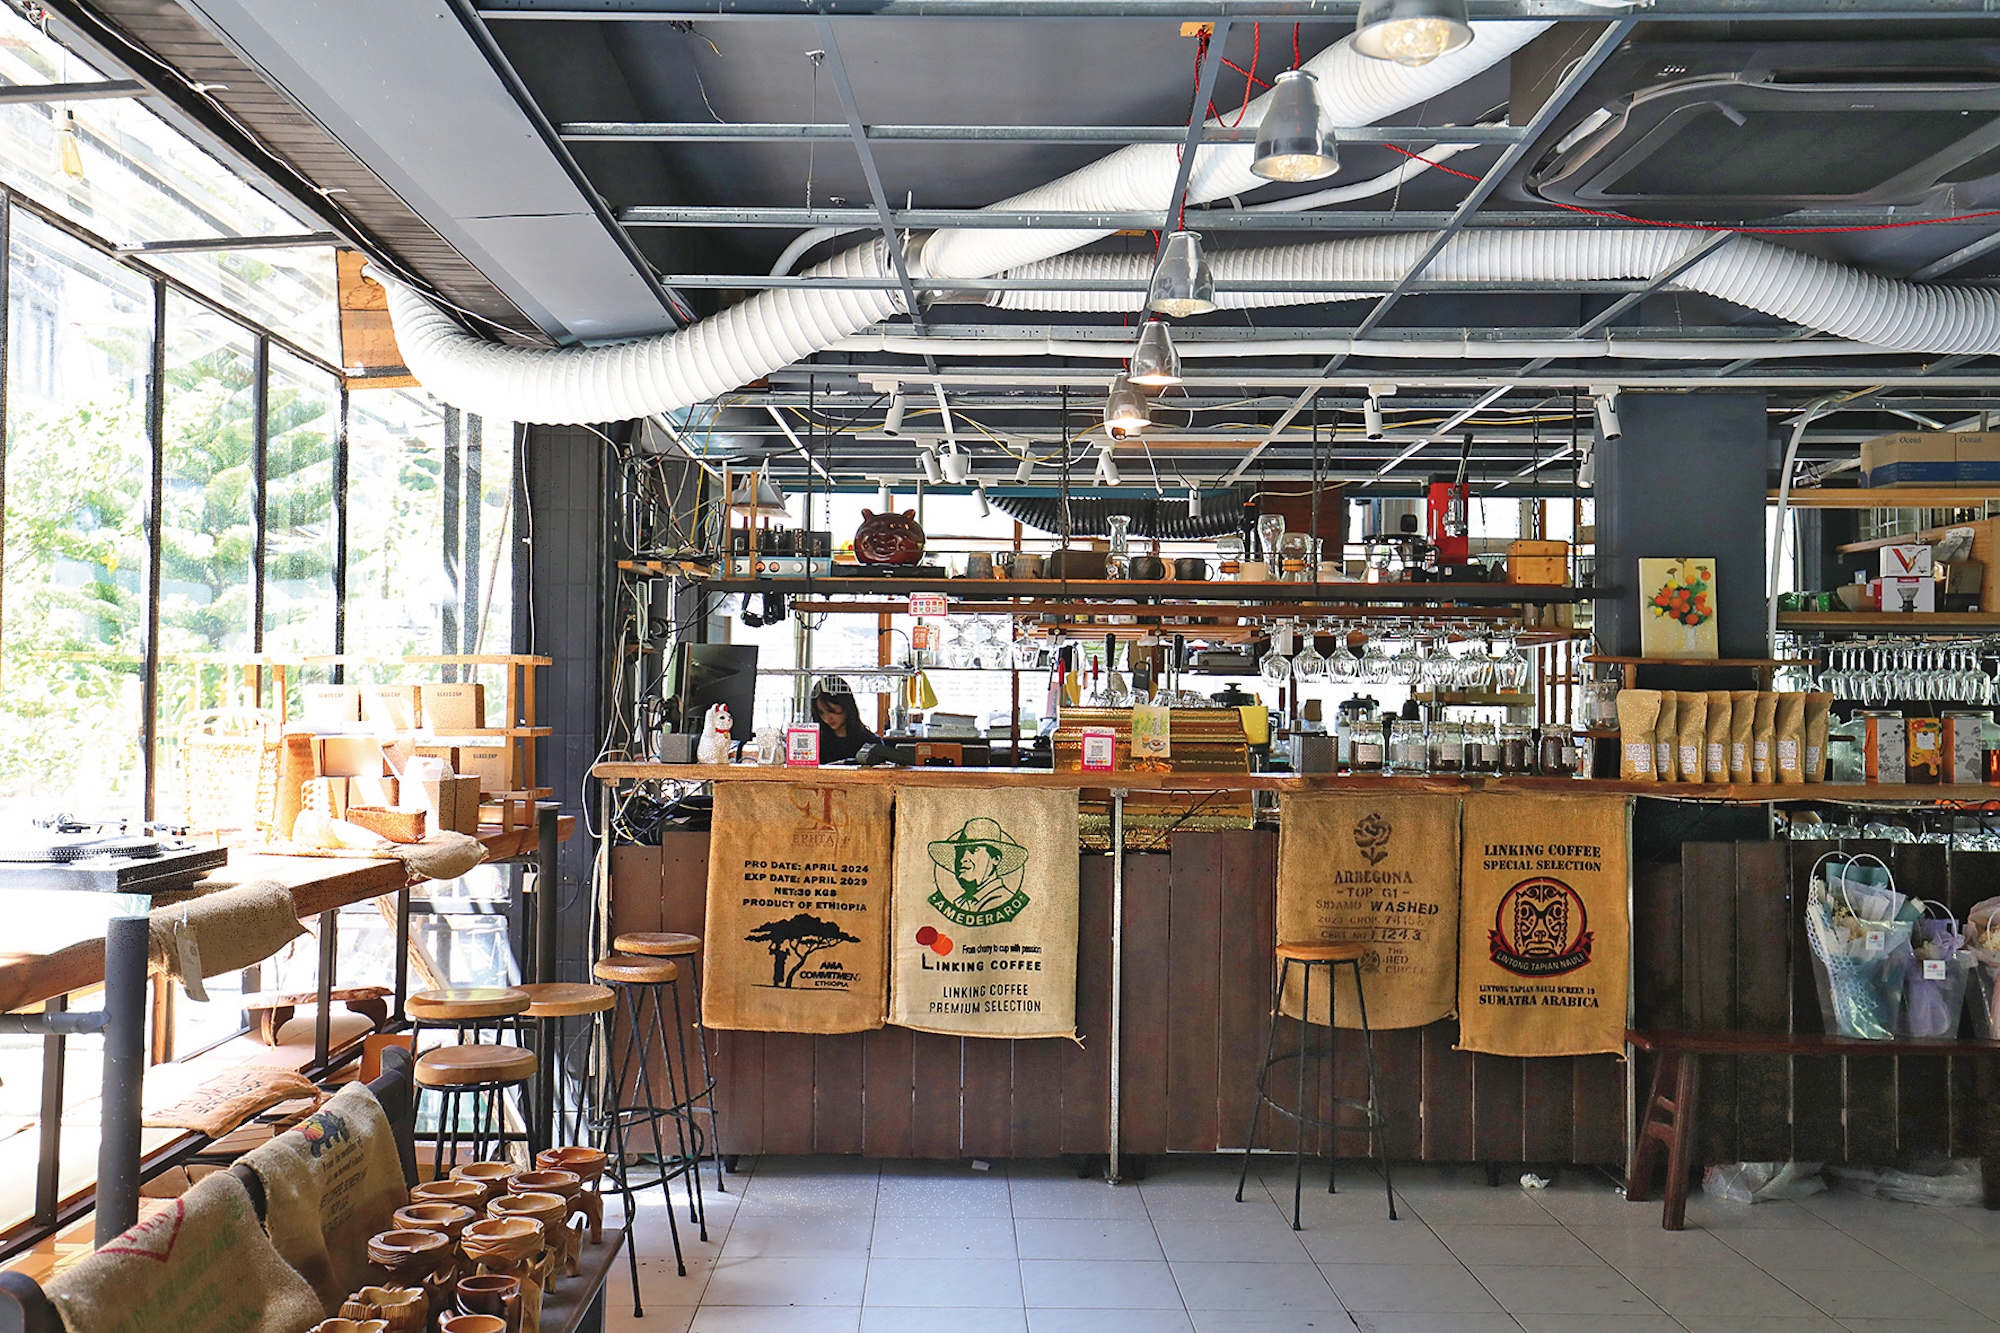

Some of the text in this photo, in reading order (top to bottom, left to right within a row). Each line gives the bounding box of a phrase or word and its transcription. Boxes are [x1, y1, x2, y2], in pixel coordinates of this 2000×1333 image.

[1484, 844, 1600, 858] LINKING COFFEE
[771, 861, 801, 870] DATE:
[805, 864, 838, 872] APRIL
[1483, 860, 1601, 872] SPECIAL SELECTION
[770, 874, 800, 883] DATE:
[804, 876, 837, 885] APRIL
[840, 878, 868, 886] 2029
[1334, 871, 1413, 884] ARBEGONA
[743, 899, 794, 908] PRODUCT
[816, 902, 867, 911] ETHIOPIA
[1371, 901, 1439, 915] WASHED
[934, 899, 1021, 925] AMEDERARO
[990, 960, 1041, 971] COFFEE
[1386, 956, 1408, 964] RED
[1496, 953, 1585, 970] LINTONG TAPIAN NAULI
[944, 984, 1028, 998] LINKING COFFEE
[929, 1000, 1041, 1014] PREMIUM SELECTION
[1479, 995, 1599, 1008] SUMATRA ARABICA
